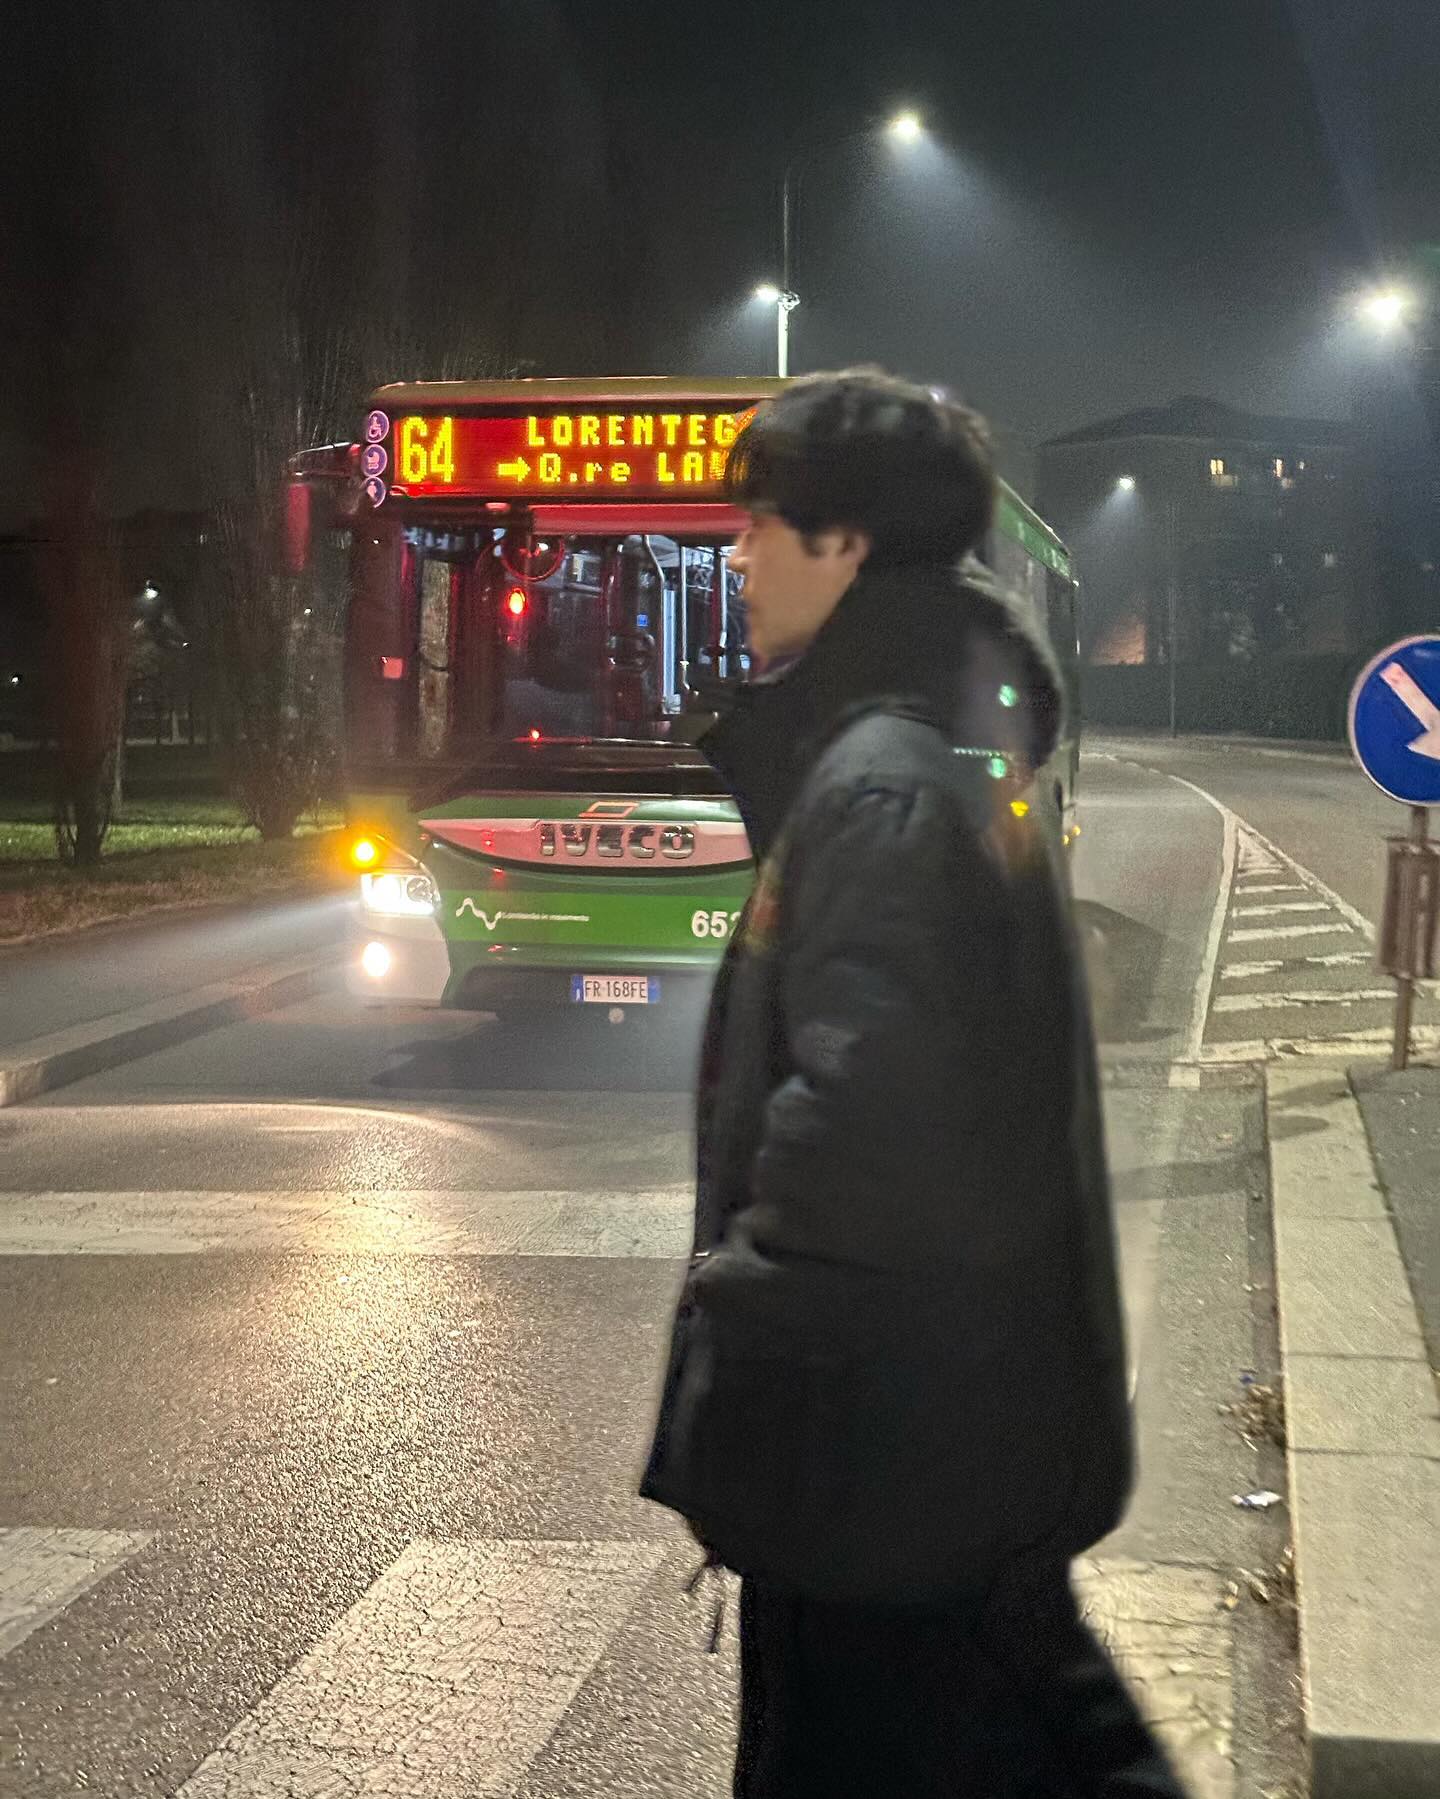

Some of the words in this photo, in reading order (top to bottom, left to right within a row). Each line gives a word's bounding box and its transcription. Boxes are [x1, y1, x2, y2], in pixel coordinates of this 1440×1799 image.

[527, 415, 735, 446] LORENTEG
[402, 416, 454, 482] 64
[539, 453, 630, 482] Q.re
[540, 823, 695, 859] IVECO
